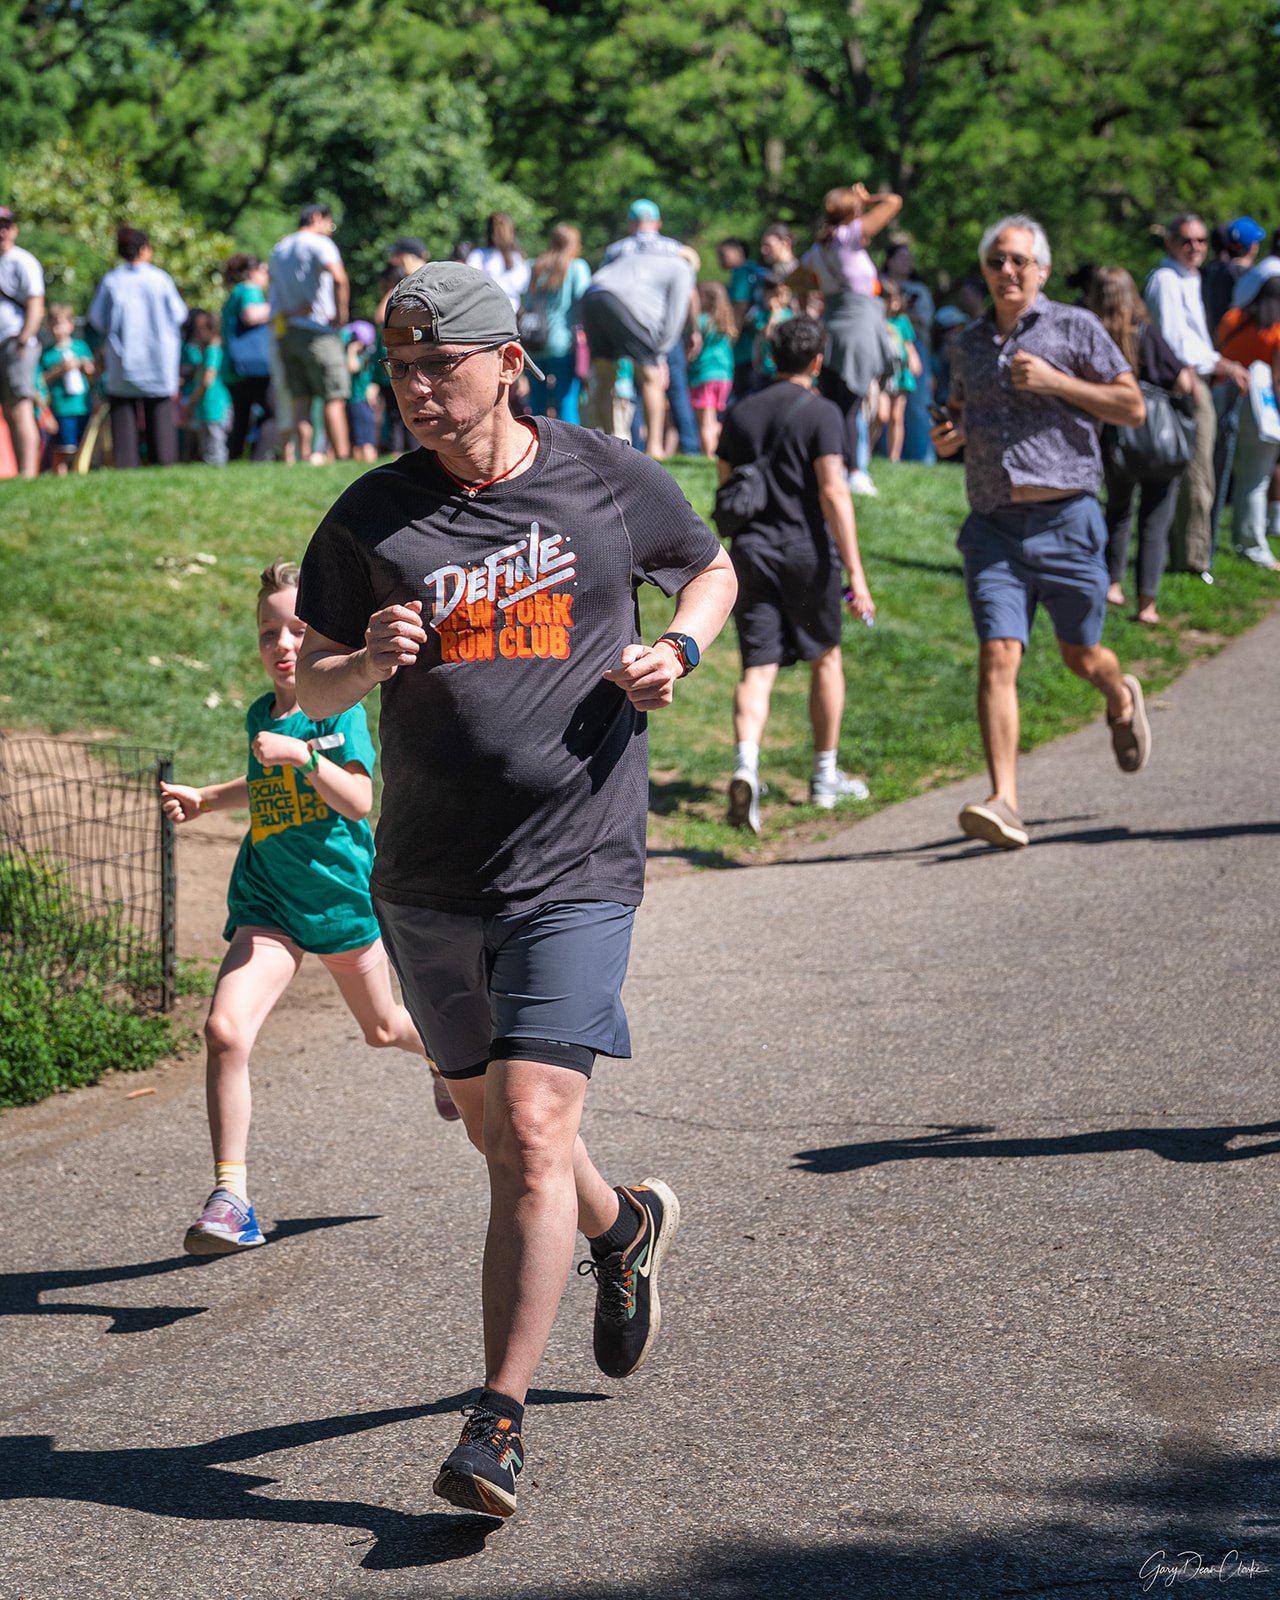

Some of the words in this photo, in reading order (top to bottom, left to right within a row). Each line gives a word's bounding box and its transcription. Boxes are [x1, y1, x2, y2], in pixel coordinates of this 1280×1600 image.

[441, 629, 496, 663] RUN
[499, 624, 571, 660] CLUB
[250, 782, 291, 800] OCIAL
[260, 811, 295, 826] RUN
[302, 805, 330, 822] 20
